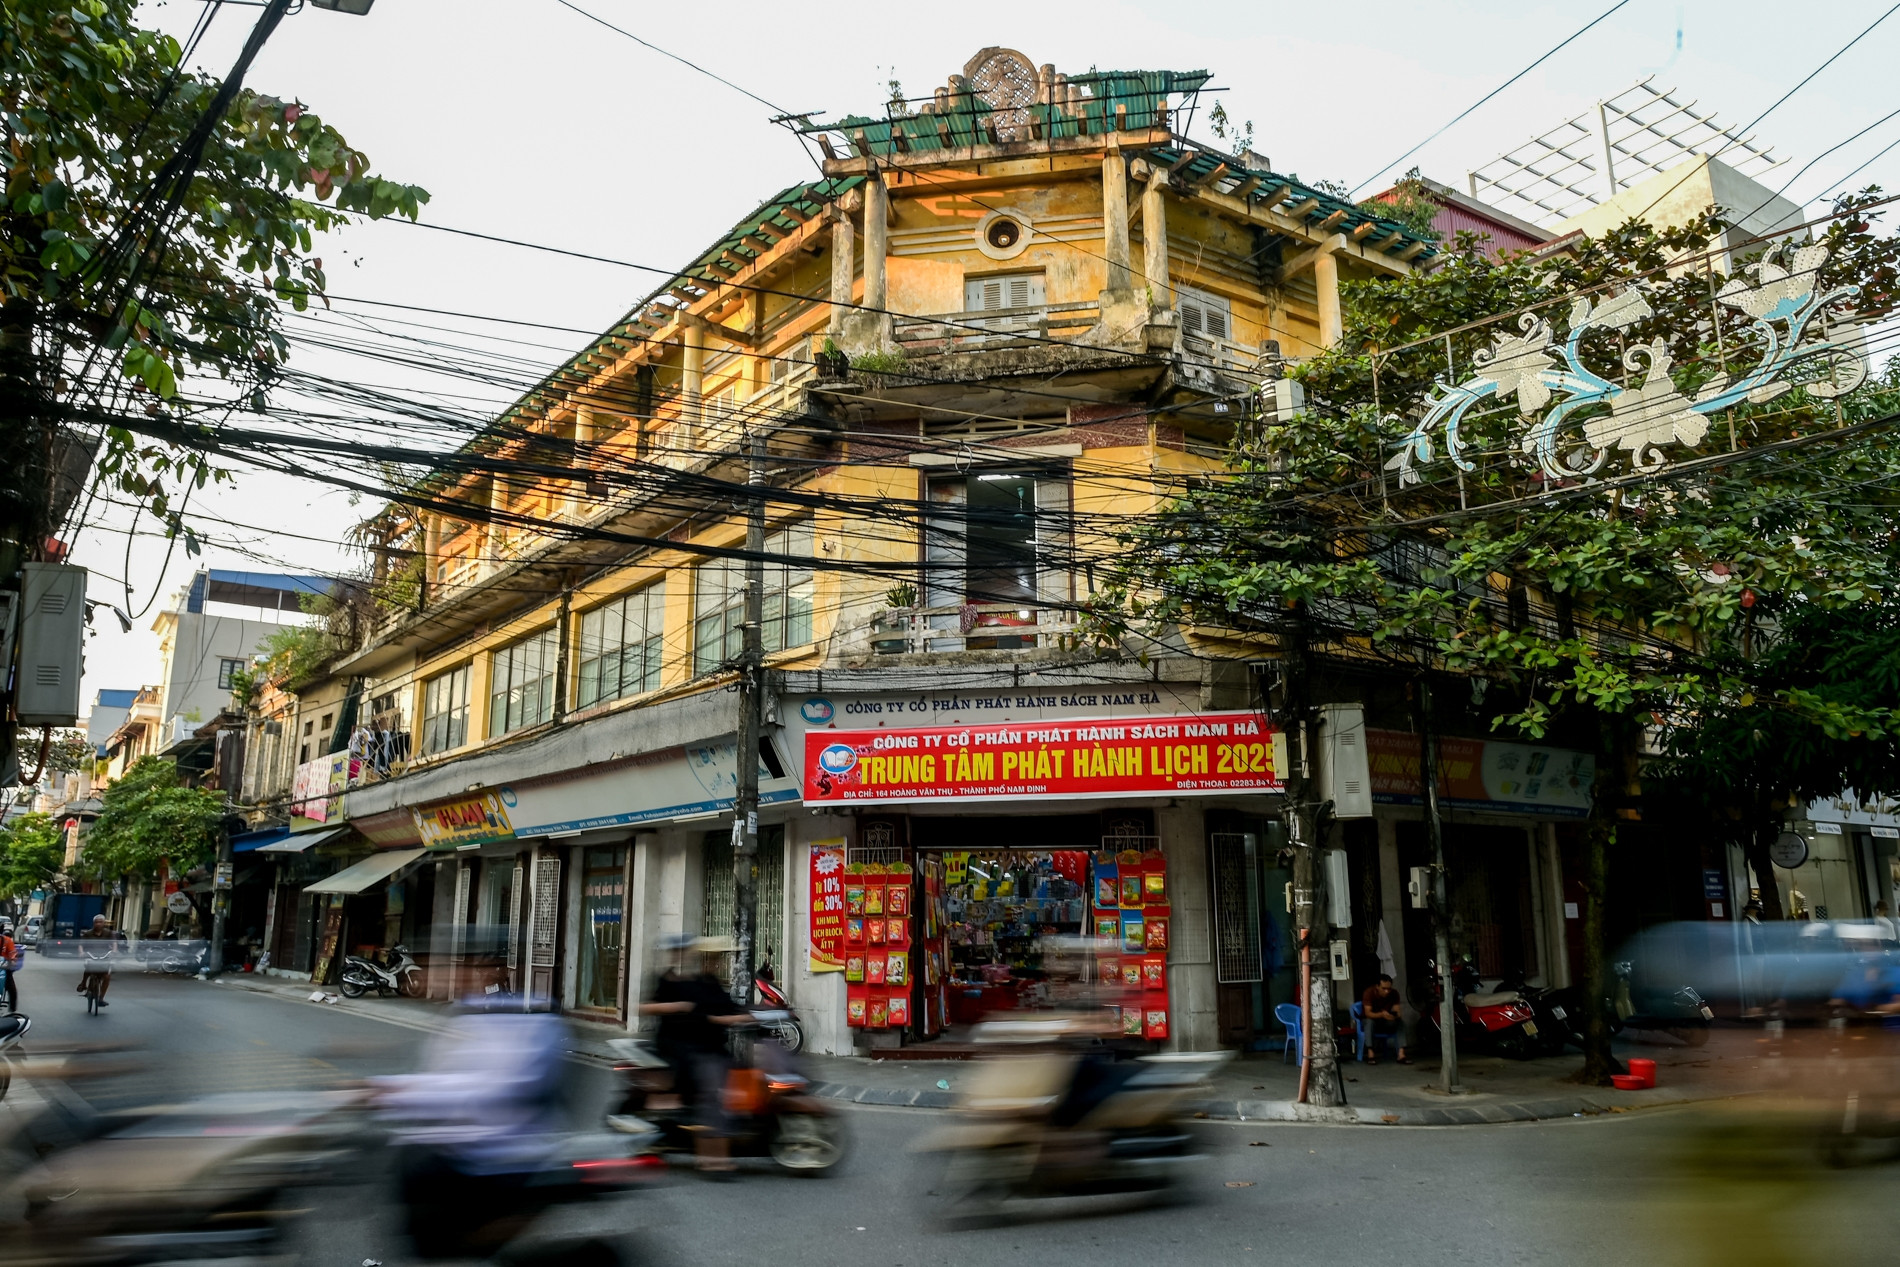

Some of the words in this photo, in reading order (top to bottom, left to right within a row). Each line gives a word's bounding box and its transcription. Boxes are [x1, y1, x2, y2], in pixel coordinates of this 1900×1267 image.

[845, 699, 883, 714] CÔNG
[886, 701, 904, 713] TY
[909, 696, 927, 712] CỔ
[932, 694, 970, 711] PHẦN
[975, 694, 1012, 709] PHÁT
[1015, 694, 1057, 708] HÀNH
[1060, 692, 1097, 707] SÁCH
[1101, 693, 1135, 706] NAM
[1139, 690, 1160, 704] HÀ
[873, 734, 918, 749] CÔNG
[923, 734, 942, 748] TY
[947, 729, 970, 746] CỔ
[975, 728, 1022, 745] PHẦN
[1026, 727, 1071, 743] PHÁT
[1076, 725, 1125, 742] HÀNH
[1131, 723, 1180, 739] SÁCH
[1185, 723, 1228, 738] NAM
[1234, 720, 1259, 736] HÀ
[858, 754, 935, 785] TRUNG
[942, 747, 994, 783] TÂM
[1002, 744, 1066, 780] PHÁT
[1073, 742, 1142, 778] HÀNH
[1151, 744, 1209, 782] LỊCH
[843, 790, 857, 799] ĐỊA
[858, 788, 874, 798] CHỈ:
[875, 789, 888, 797] 164
[889, 787, 917, 797] HOÀNG
[919, 787, 935, 796] VĂN
[936, 787, 953, 798] THỤ
[959, 785, 987, 796] THÀNH
[988, 784, 1005, 795] PHỐ
[1007, 785, 1025, 794] NAM
[1026, 785, 1047, 795] ĐỊNH
[1176, 779, 1197, 790] ĐIỆN
[1199, 780, 1228, 789] THOẠI:
[823, 876, 840, 893] 10%
[825, 894, 842, 911] 30%
[816, 916, 825, 925] KHI
[826, 914, 839, 924] MUA
[825, 927, 843, 937] BLOCK
